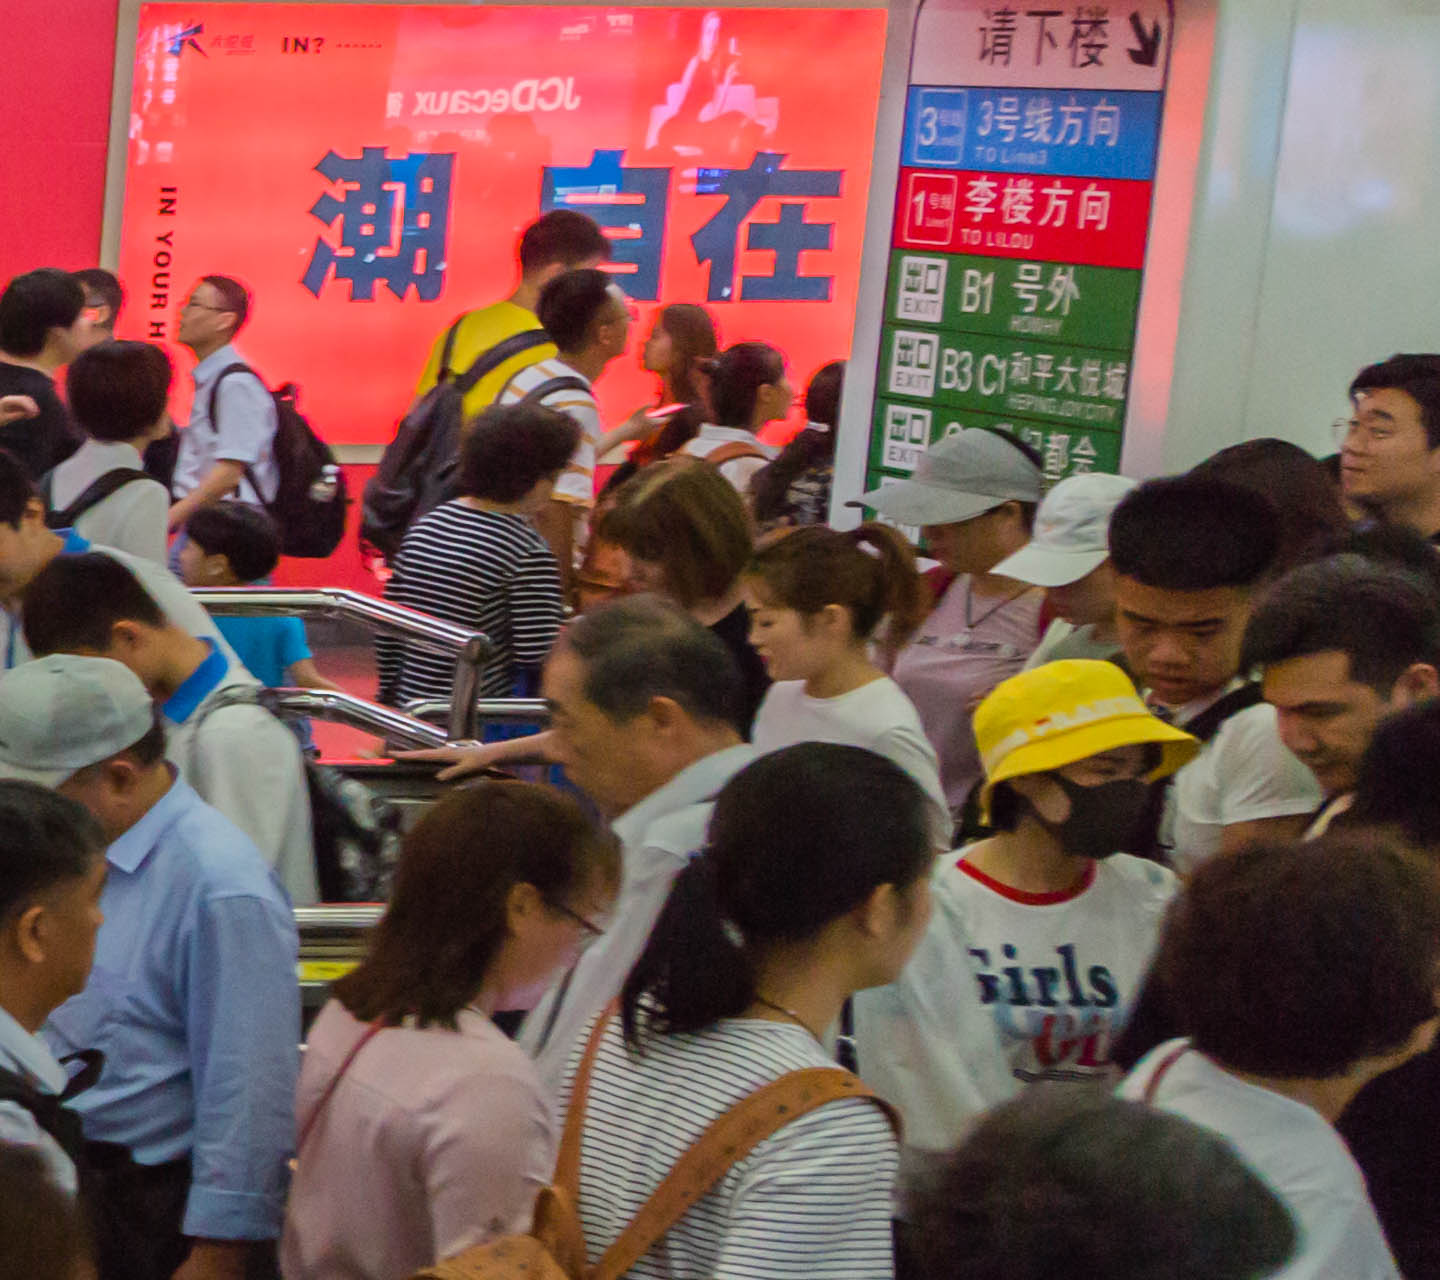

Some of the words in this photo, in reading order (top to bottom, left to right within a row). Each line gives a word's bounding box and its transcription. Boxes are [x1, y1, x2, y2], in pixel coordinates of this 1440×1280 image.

[282, 37, 325, 54] IN?
[978, 7, 1110, 69] 请下楼
[920, 107, 938, 146] 3
[977, 95, 1120, 147] 3号线方向
[975, 146, 996, 161] TO
[160, 187, 177, 216] IN
[964, 176, 1111, 231] 李楼方向
[301, 146, 457, 302] 潮
[541, 149, 846, 302] 自在
[961, 228, 981, 245] TO
[986, 231, 1034, 250] LILOU
[154, 231, 175, 308] YOUR
[904, 262, 941, 294] 出口
[961, 269, 996, 314] B1
[1011, 263, 1080, 315] 号外
[903, 297, 941, 318] EXIT
[897, 336, 932, 369] 出口
[894, 371, 932, 390] EXIT
[940, 348, 974, 392] B3
[979, 354, 1008, 396] C1
[1010, 351, 1127, 400] 和平大悦城
[890, 411, 926, 445] 出口
